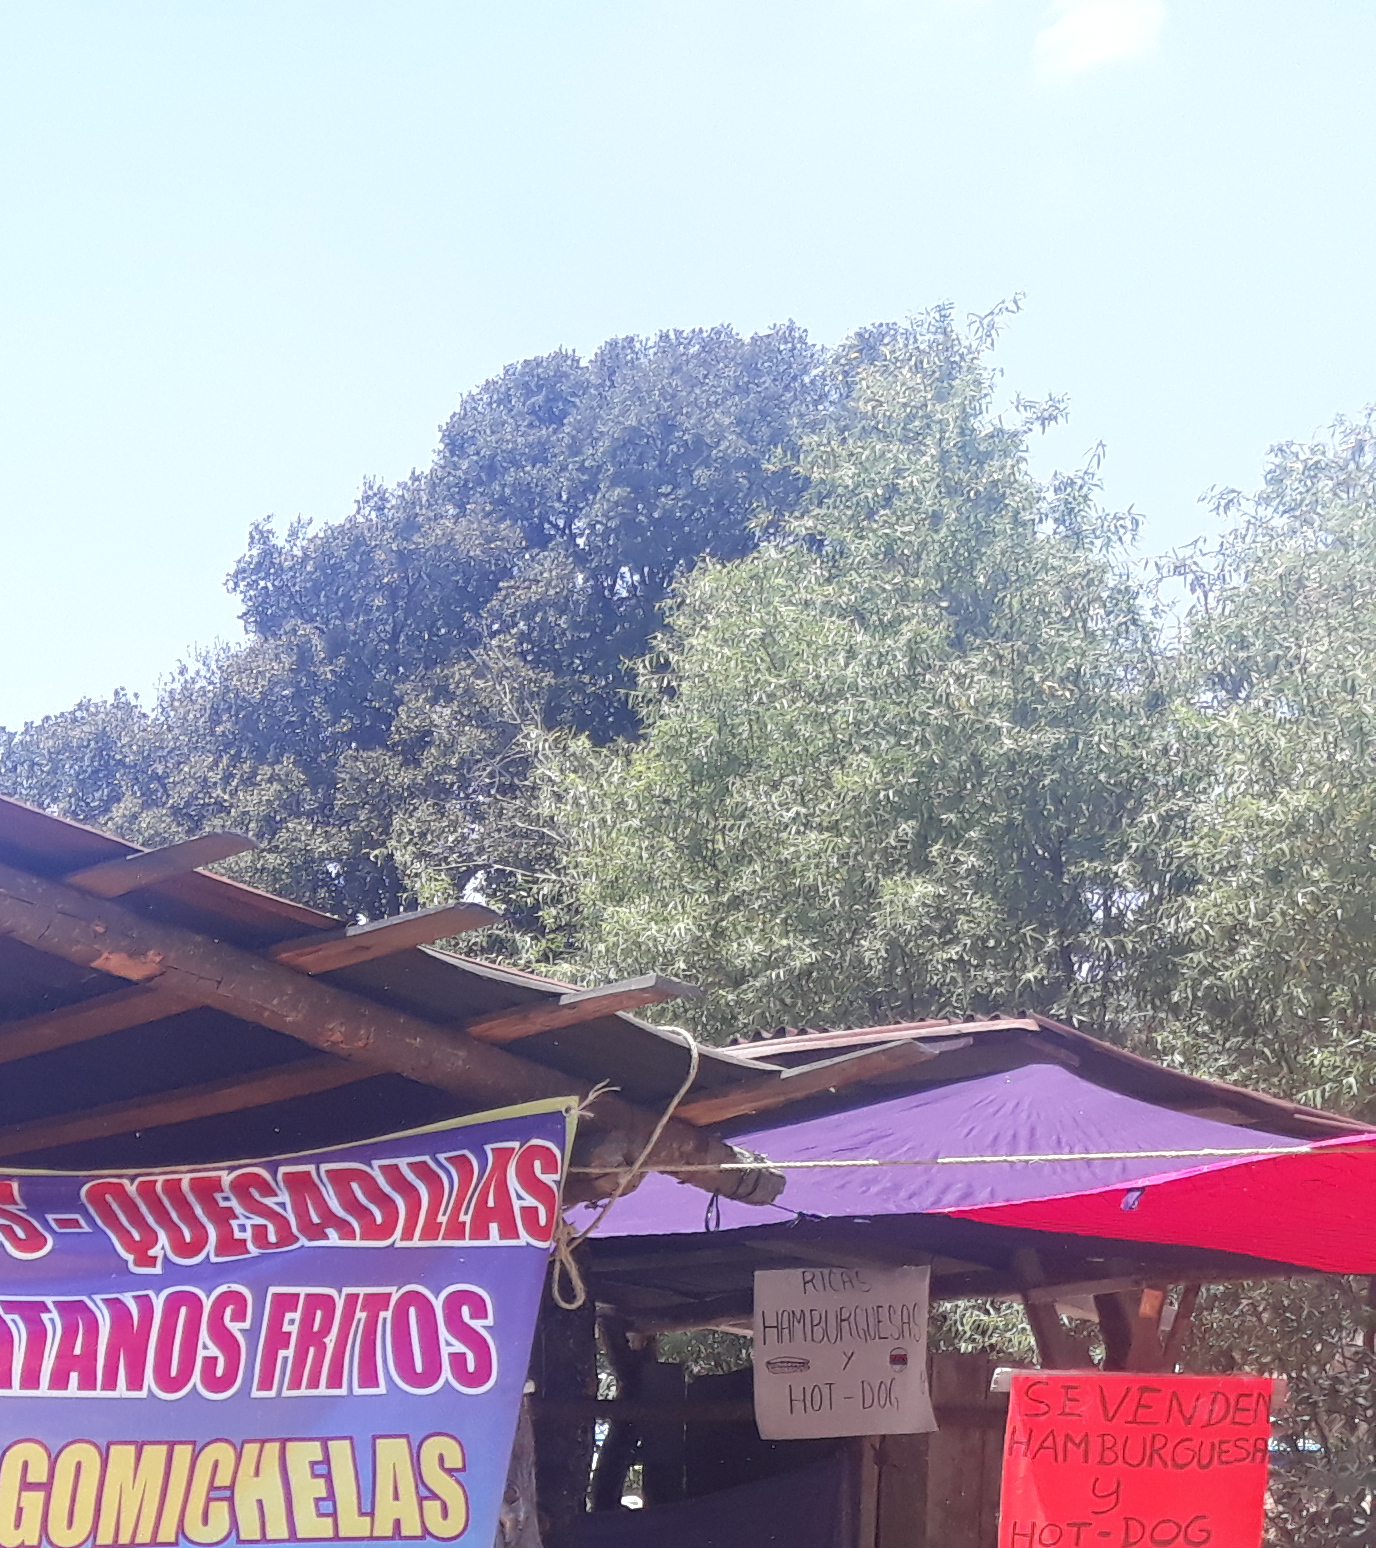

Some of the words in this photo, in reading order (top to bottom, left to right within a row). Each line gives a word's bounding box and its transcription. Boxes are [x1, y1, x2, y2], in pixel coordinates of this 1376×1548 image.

[81, 1139, 562, 1275] QUESADILLAS
[802, 1270, 872, 1294] RICAS
[250, 1284, 498, 1398] FRITOS
[762, 1301, 922, 1346] HAMBURGUESAS
[1024, 1380, 1083, 1418] SE
[1098, 1384, 1272, 1428] VENDEN
[1008, 1425, 1269, 1470] HAMBURGUESA
